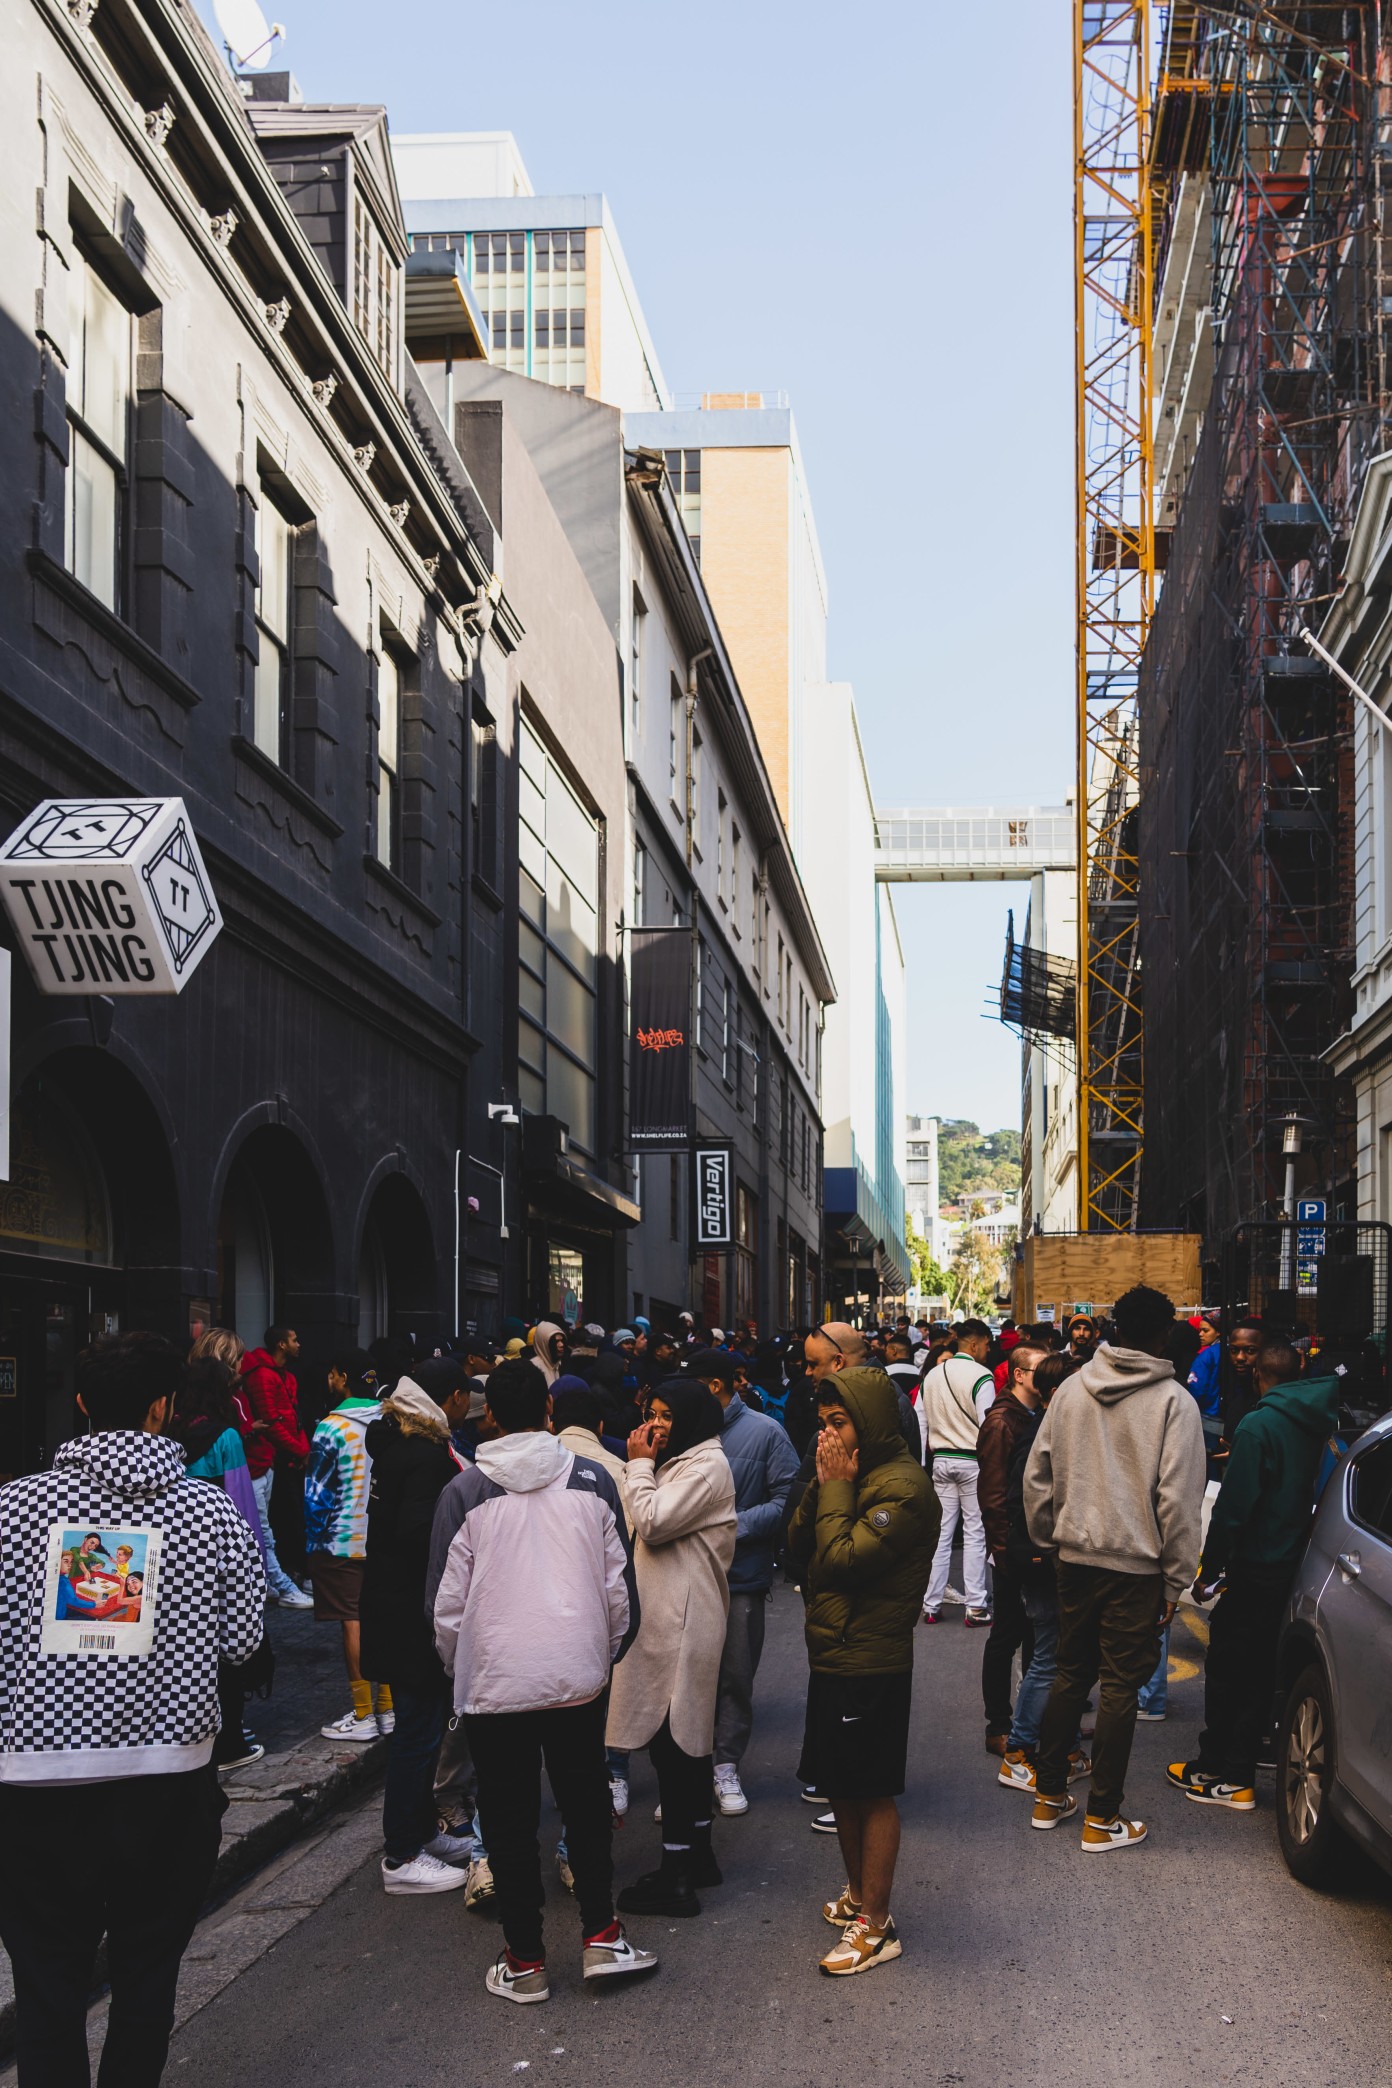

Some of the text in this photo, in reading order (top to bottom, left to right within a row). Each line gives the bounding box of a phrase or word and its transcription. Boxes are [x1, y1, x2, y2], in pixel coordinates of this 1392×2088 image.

[9, 879, 136, 930] TJING
[170, 877, 190, 913] TT
[32, 934, 155, 983] TJING
[702, 1156, 725, 1236] Vertigo
[1304, 1203, 1318, 1219] P
